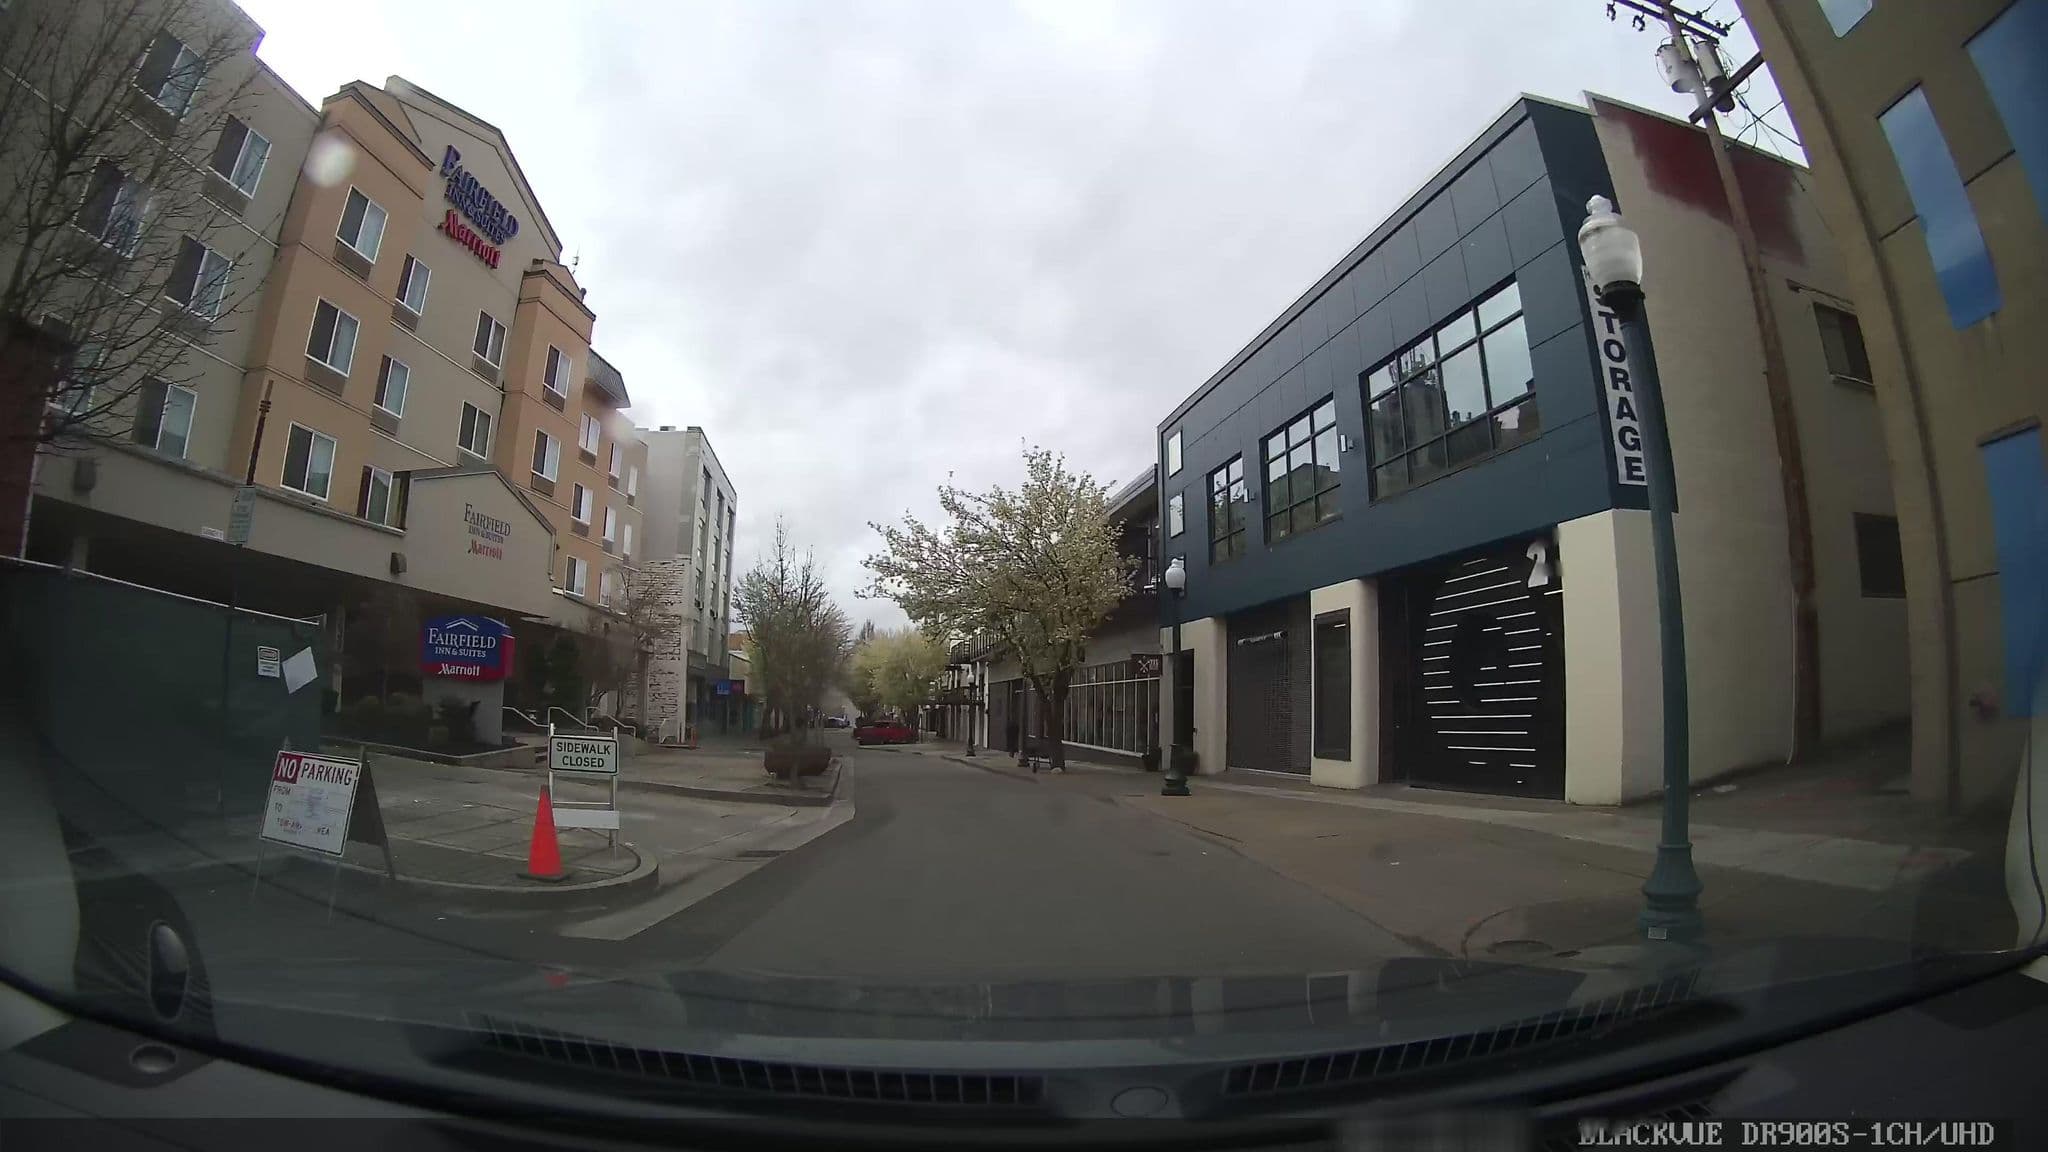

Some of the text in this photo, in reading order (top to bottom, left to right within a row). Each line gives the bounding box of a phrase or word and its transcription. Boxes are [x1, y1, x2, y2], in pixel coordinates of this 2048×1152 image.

[440, 145, 519, 238] FAIRFIELD
[437, 209, 501, 268] Marriott
[464, 503, 511, 536] FAIRFIELD
[467, 539, 503, 560] Marriott
[428, 628, 496, 649] FAIRFIELD
[435, 647, 486, 658] INN & SUITES
[438, 663, 480, 676] Marriott
[556, 742, 611, 755] SIDEWALK
[277, 757, 353, 785] NO PARKING
[562, 756, 605, 768] CLOSED
